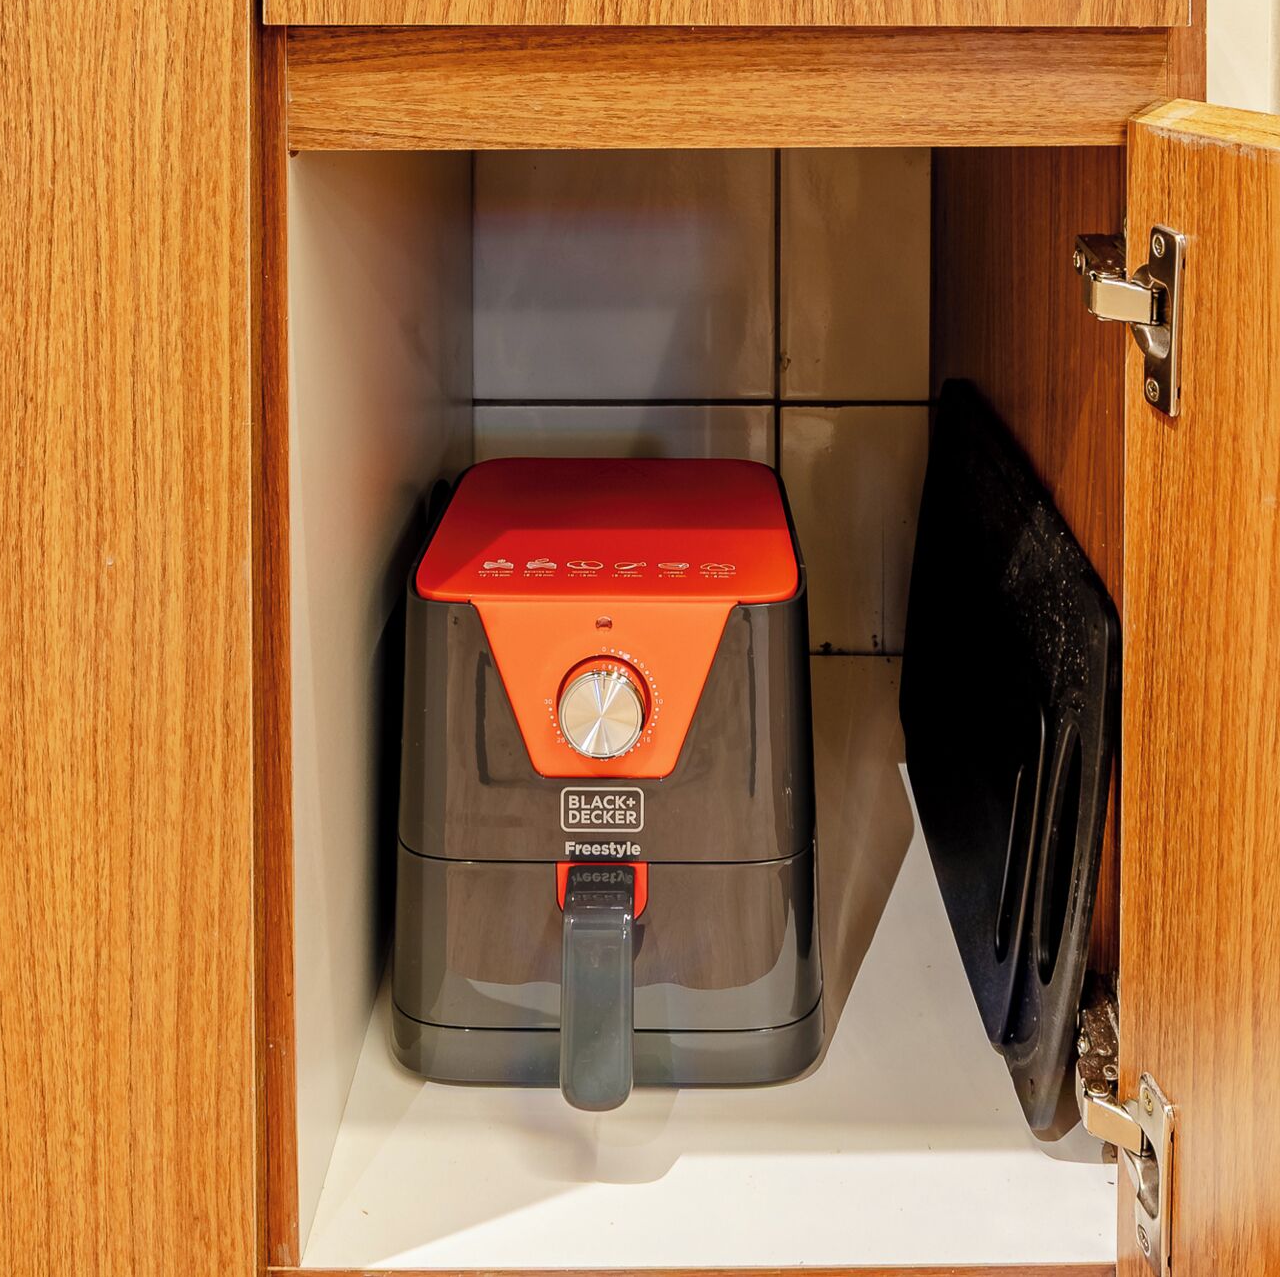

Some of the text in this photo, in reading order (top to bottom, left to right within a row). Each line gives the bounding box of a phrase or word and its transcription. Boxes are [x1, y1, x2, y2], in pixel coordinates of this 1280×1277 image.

[568, 795, 636, 809] BLACK+
[568, 810, 637, 824] DECKER
[564, 841, 641, 858] Freestyle
